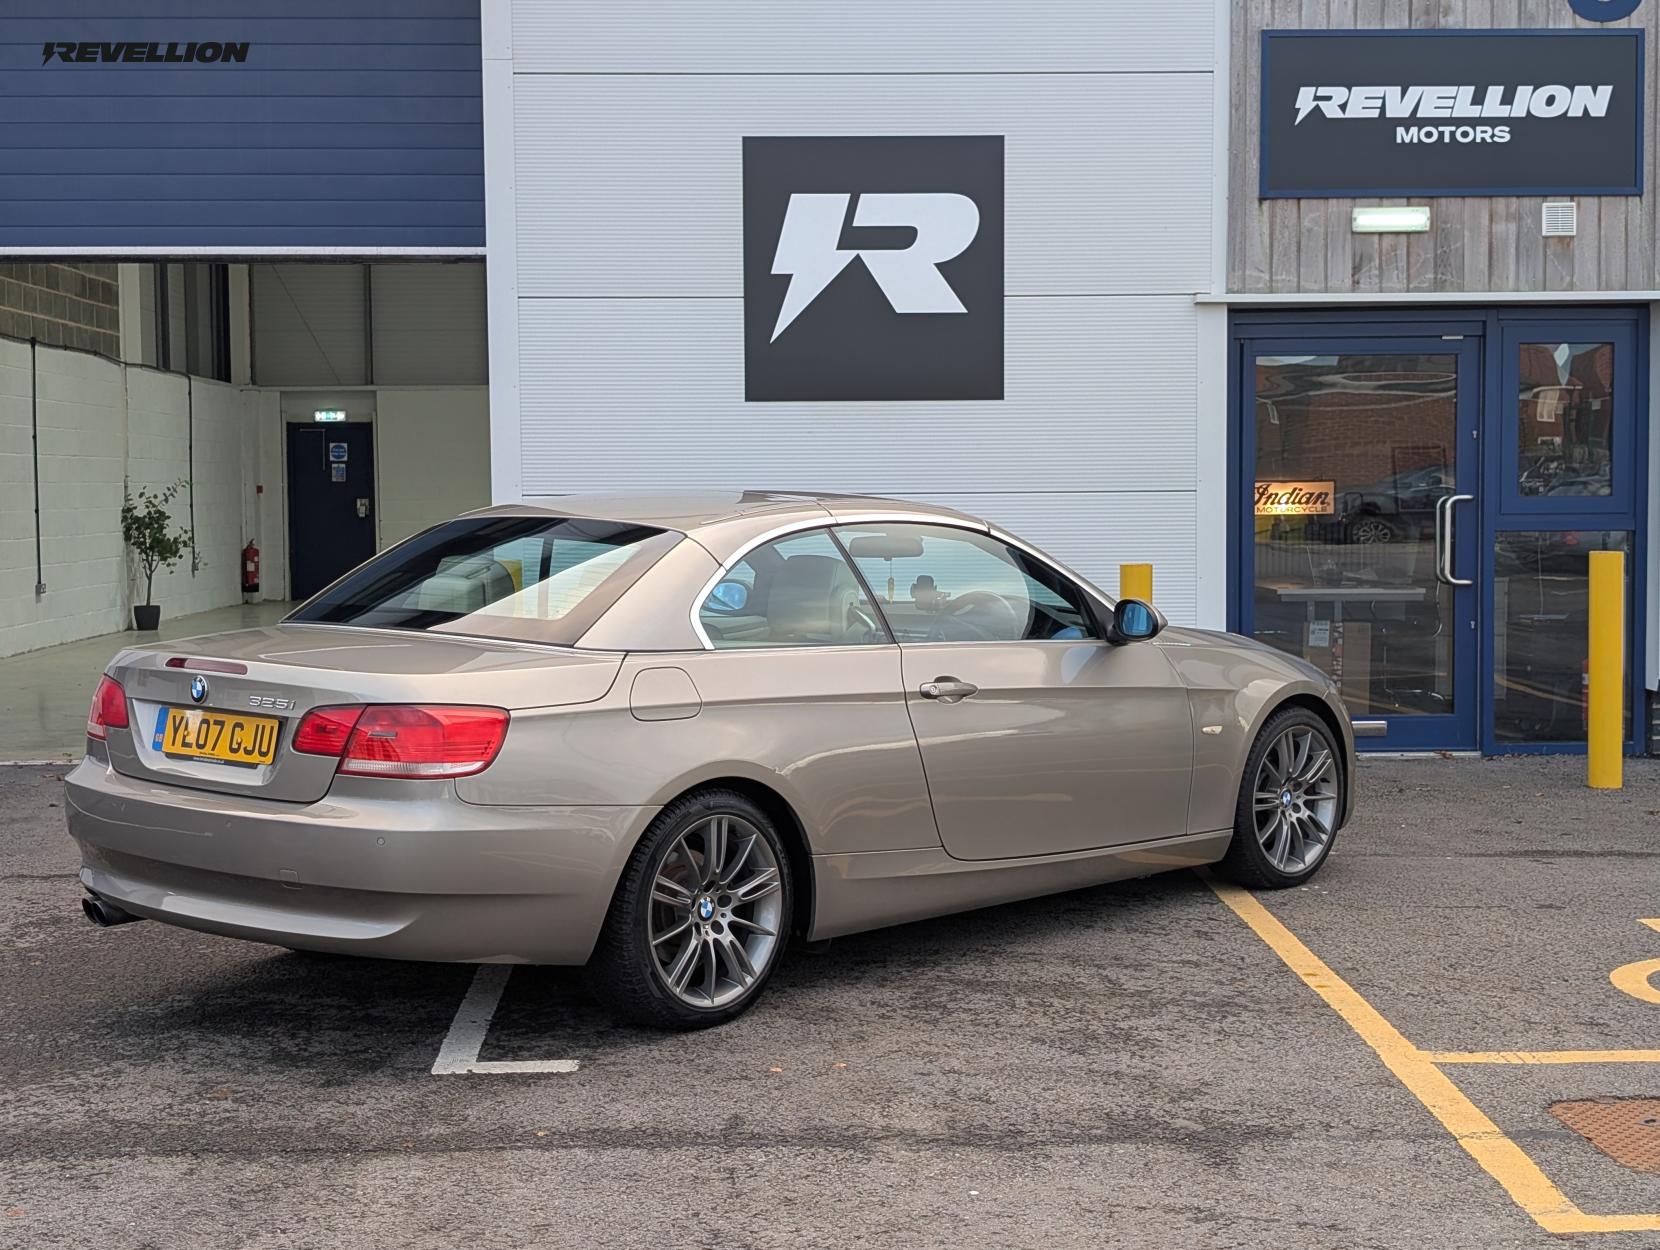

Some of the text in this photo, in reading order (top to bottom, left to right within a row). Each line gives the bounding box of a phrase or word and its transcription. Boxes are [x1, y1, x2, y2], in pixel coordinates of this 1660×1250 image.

[1295, 85, 1613, 126] REVELLION
[1396, 126, 1511, 143] MOTORS
[769, 193, 980, 344] R
[1255, 484, 1330, 505] Indian
[249, 696, 296, 710] 325i
[171, 715, 275, 757] YL07 GJU
